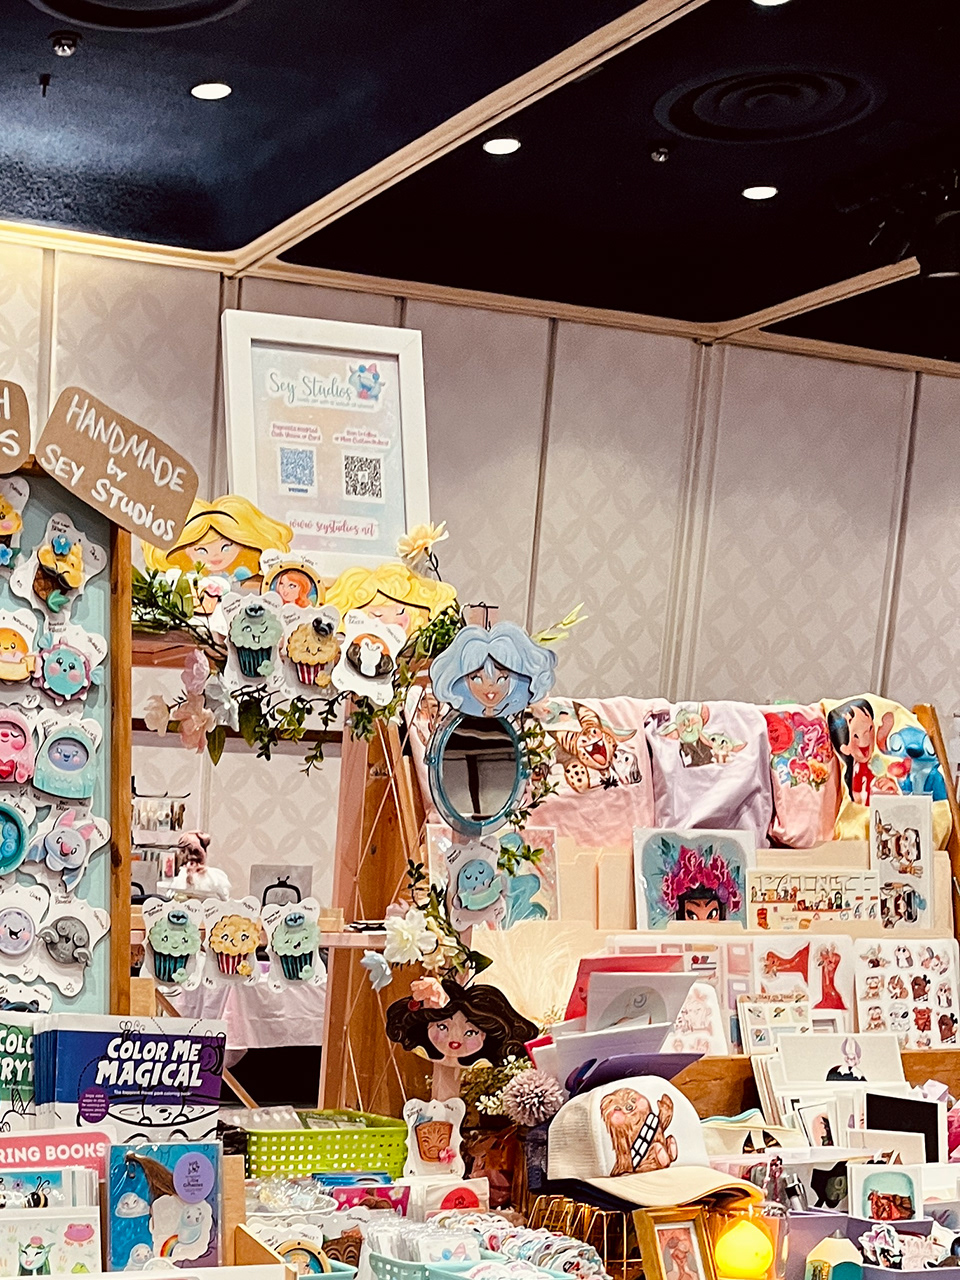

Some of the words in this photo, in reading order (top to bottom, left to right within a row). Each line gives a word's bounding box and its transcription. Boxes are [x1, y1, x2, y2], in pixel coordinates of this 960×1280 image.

[269, 372, 297, 404] Sey
[302, 375, 352, 401] Studios
[66, 394, 187, 493] HANDMADE
[40, 444, 86, 487] SEY
[91, 478, 176, 541] STUDIOS
[107, 1037, 169, 1062] COLOR
[171, 1040, 202, 1062] ME
[95, 1060, 203, 1087] MAGICAL
[45, 1142, 106, 1160] BOOKS
